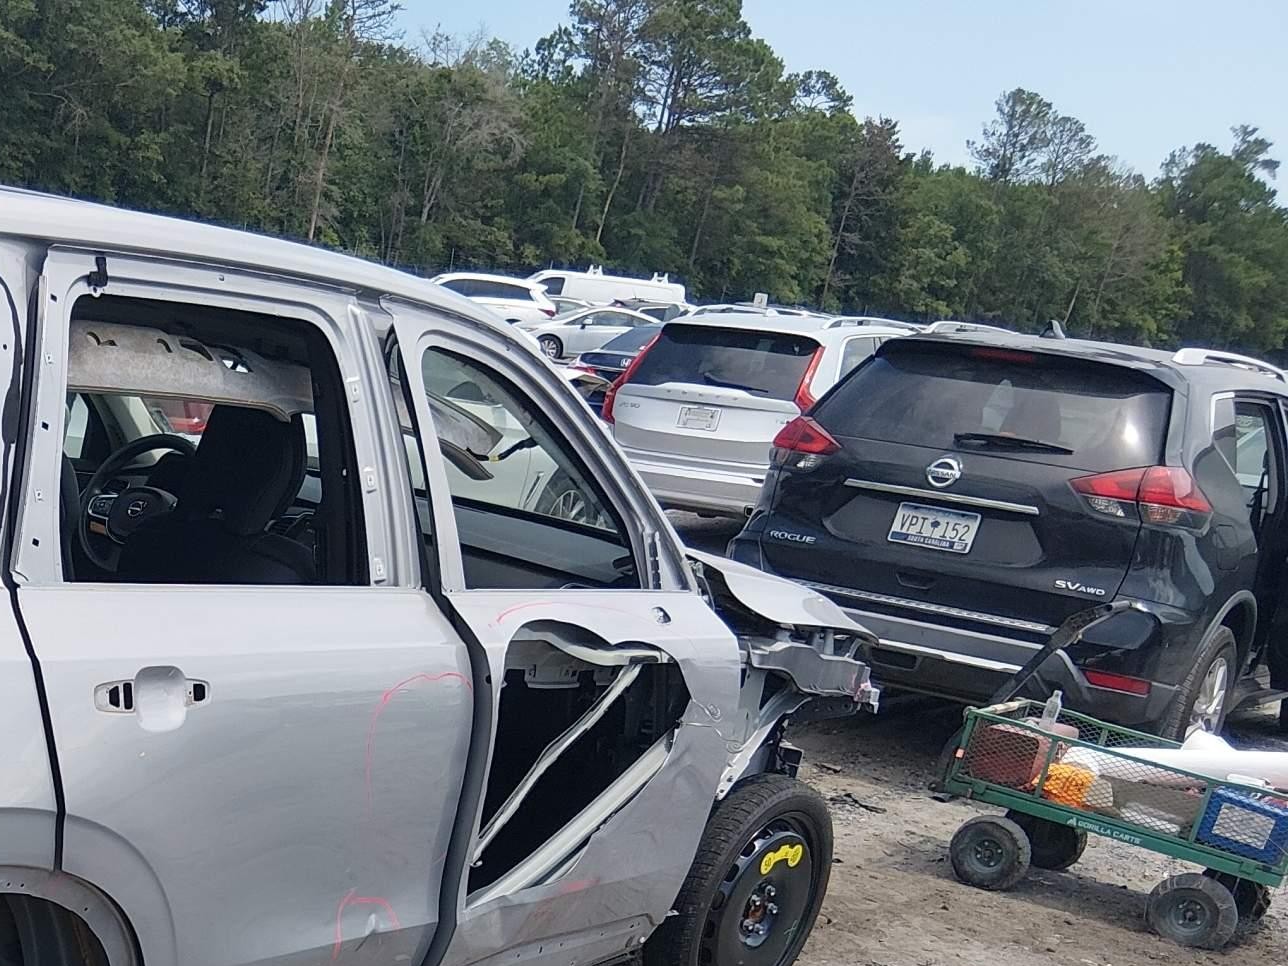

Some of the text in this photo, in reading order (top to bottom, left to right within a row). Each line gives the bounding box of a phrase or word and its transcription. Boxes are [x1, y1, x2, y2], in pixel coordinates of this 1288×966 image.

[770, 530, 817, 545] ROGUE
[899, 512, 929, 536] VPI
[939, 521, 970, 542] 152
[1054, 579, 1106, 596] SV AWD
[1078, 820, 1140, 845] GORILLA CARTS
